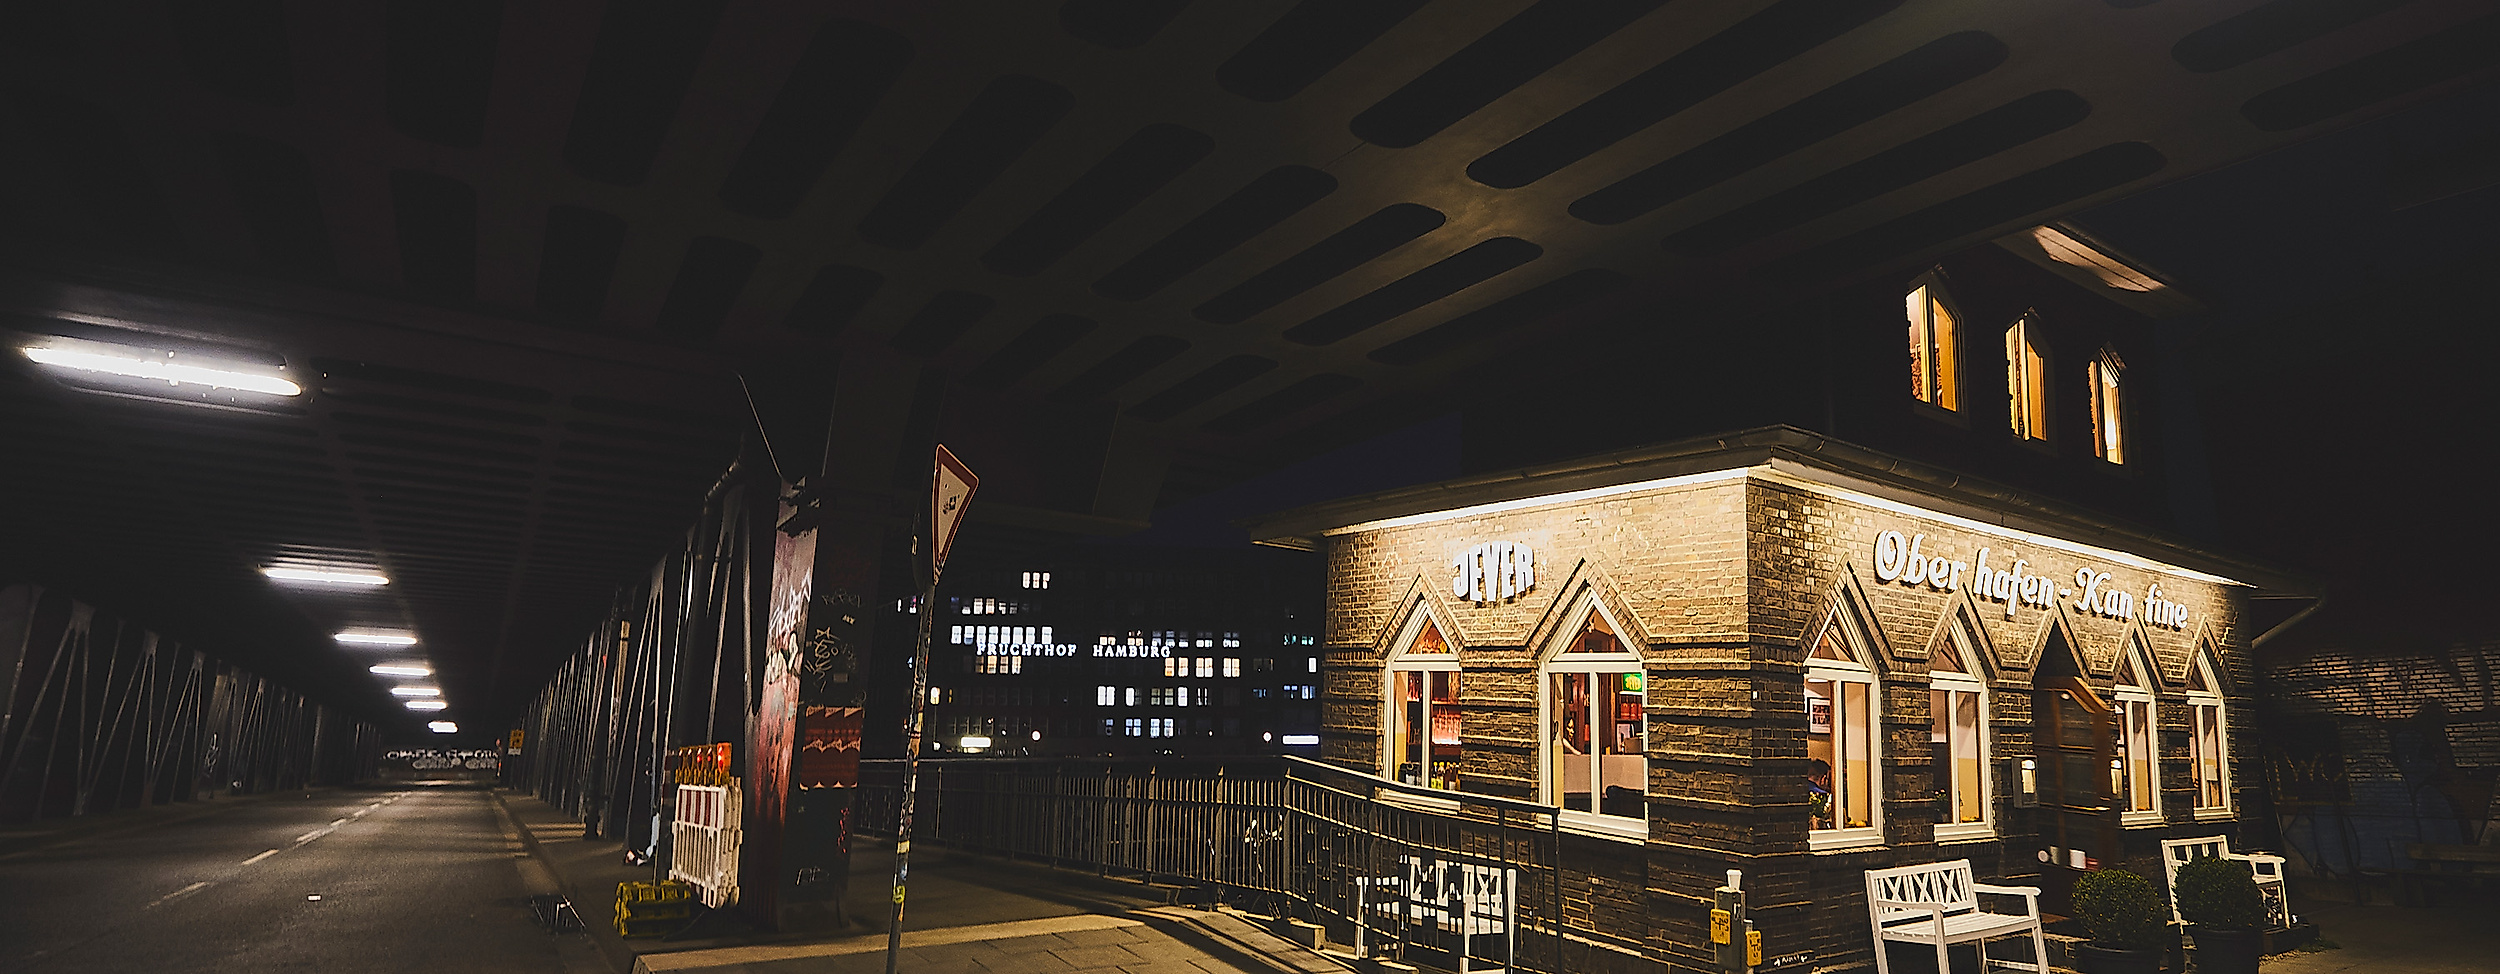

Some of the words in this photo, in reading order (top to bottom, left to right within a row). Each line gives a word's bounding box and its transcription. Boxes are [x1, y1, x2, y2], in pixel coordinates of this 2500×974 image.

[1452, 540, 1534, 602] JEVER
[1876, 530, 1967, 590] Ober
[976, 643, 1077, 656] FRUCHTHOF
[1092, 644, 1171, 658] HAMBURG
